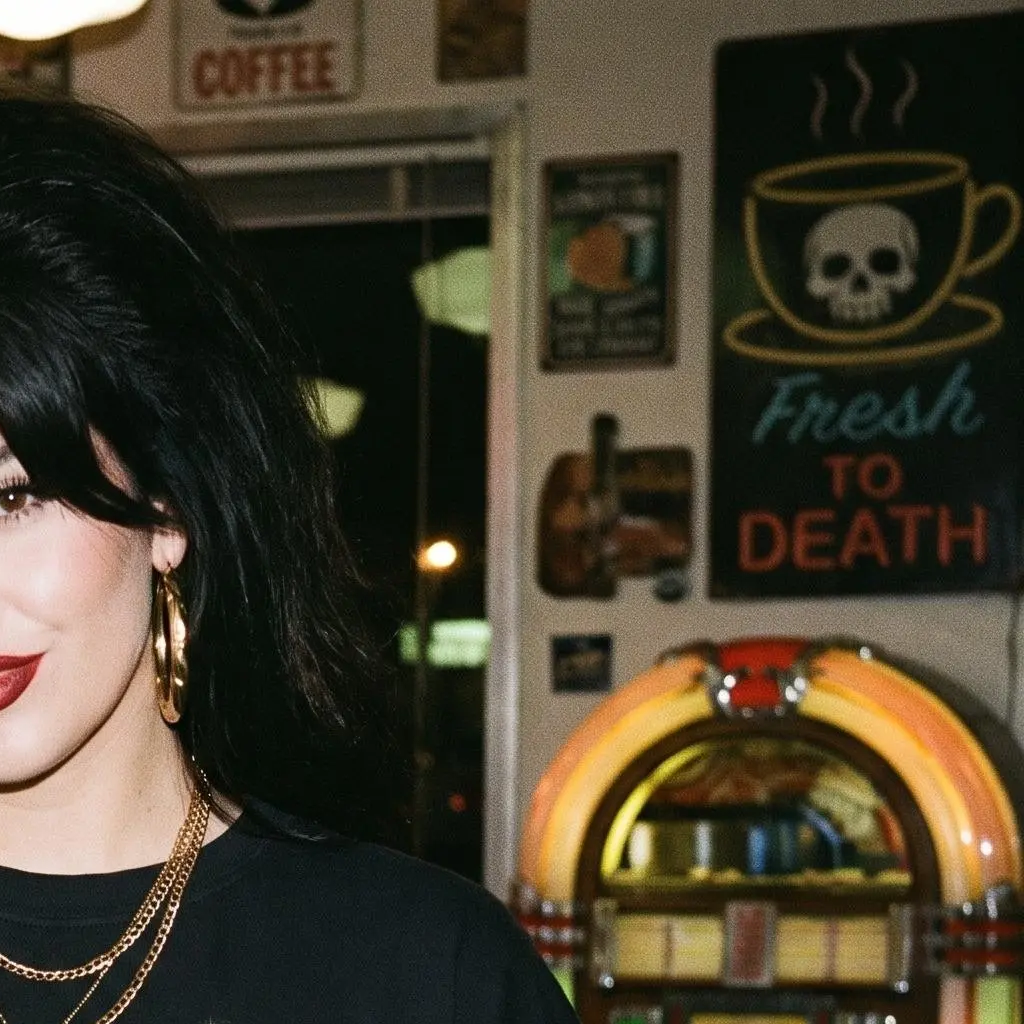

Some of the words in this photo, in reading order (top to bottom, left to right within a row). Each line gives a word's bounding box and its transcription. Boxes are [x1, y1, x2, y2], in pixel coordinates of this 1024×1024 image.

[191, 39, 338, 100] COFFEE
[751, 360, 984, 444] Fresh
[821, 452, 904, 500] TO
[737, 503, 988, 573] DEATH
